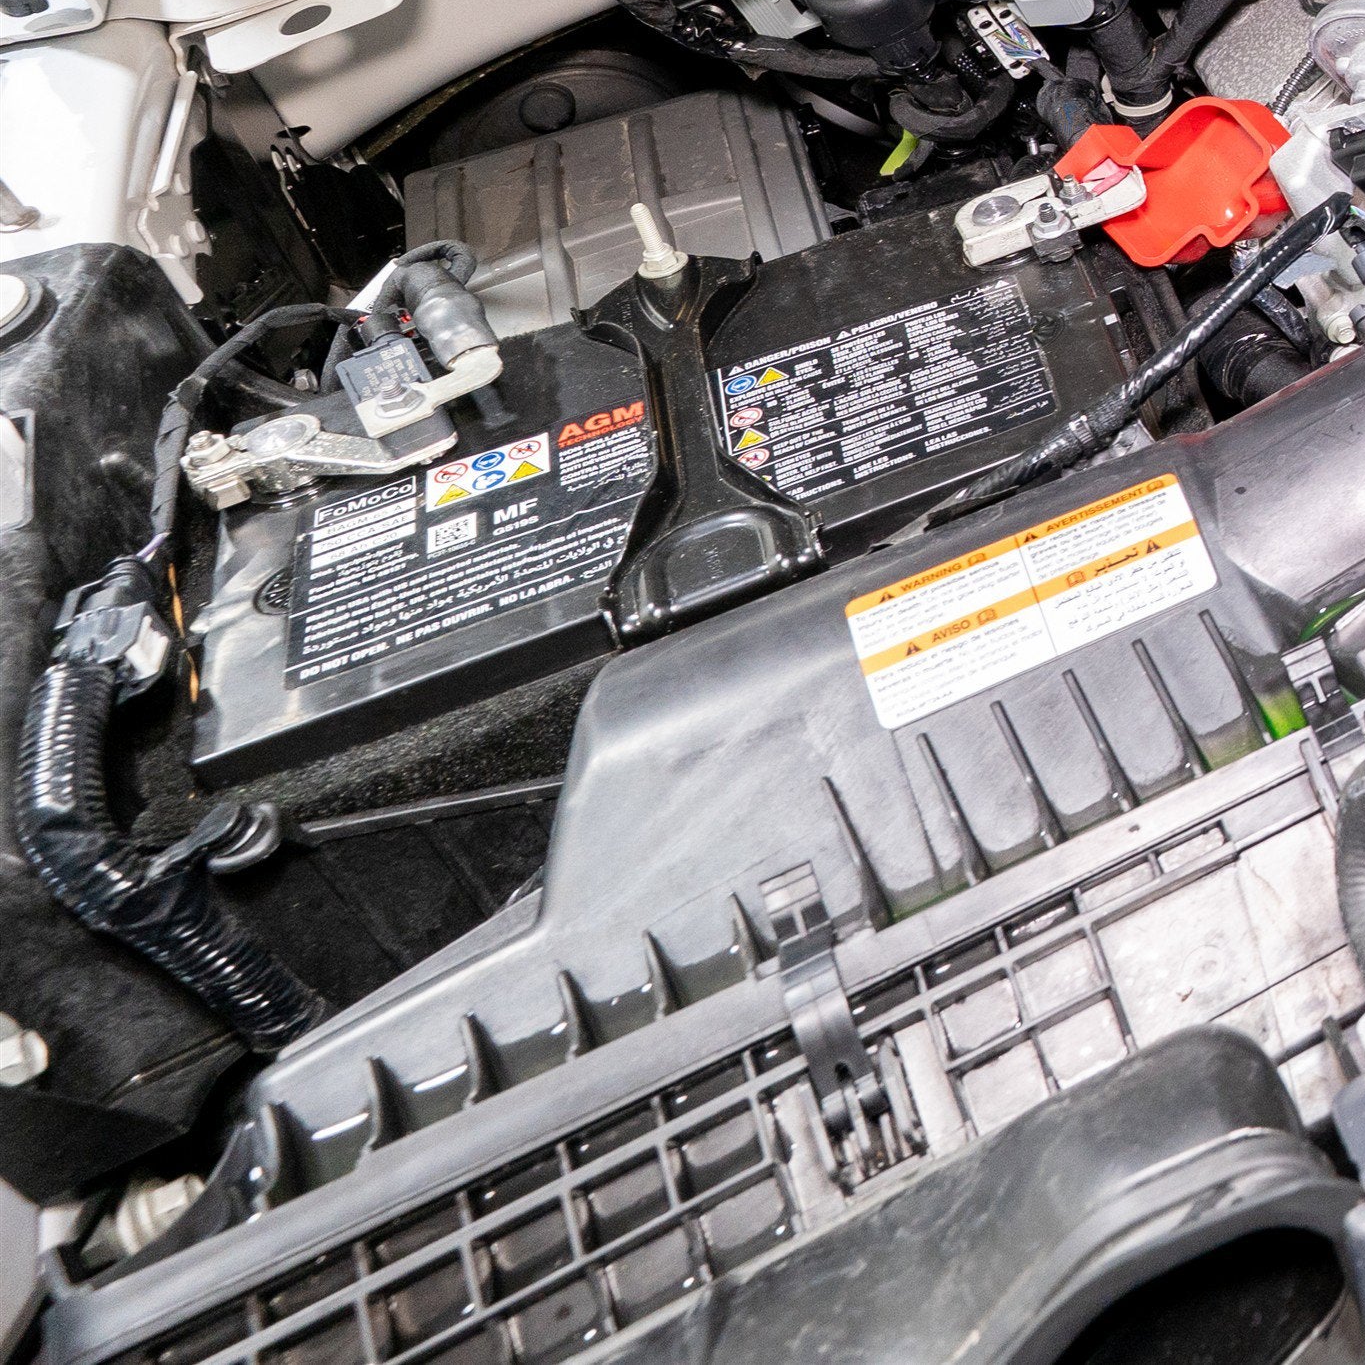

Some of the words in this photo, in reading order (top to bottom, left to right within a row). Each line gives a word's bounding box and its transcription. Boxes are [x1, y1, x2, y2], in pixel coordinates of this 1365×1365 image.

[744, 337, 830, 369] DANGER/POISON
[851, 301, 937, 334] PELIGRO/VENENO
[558, 402, 643, 444] AGM
[559, 412, 643, 447] TECHNOLOGY
[924, 437, 940, 446] LEA
[941, 431, 957, 440] LAS
[853, 462, 871, 473] LIRE
[318, 484, 411, 523] FoMoCo
[493, 498, 537, 524] MF
[1046, 488, 1141, 531] AVERTISSEMENT
[901, 563, 962, 591] WARNING
[299, 665, 320, 679] DO
[321, 655, 349, 671] NOT
[351, 642, 389, 660] OPEN.
[395, 631, 413, 644] NE
[415, 621, 440, 637] PAS
[442, 603, 492, 627] OUVRIR.
[499, 593, 517, 606] NO
[519, 587, 536, 599] LA
[538, 575, 574, 593] ABRA.
[932, 619, 970, 642] AVISO
